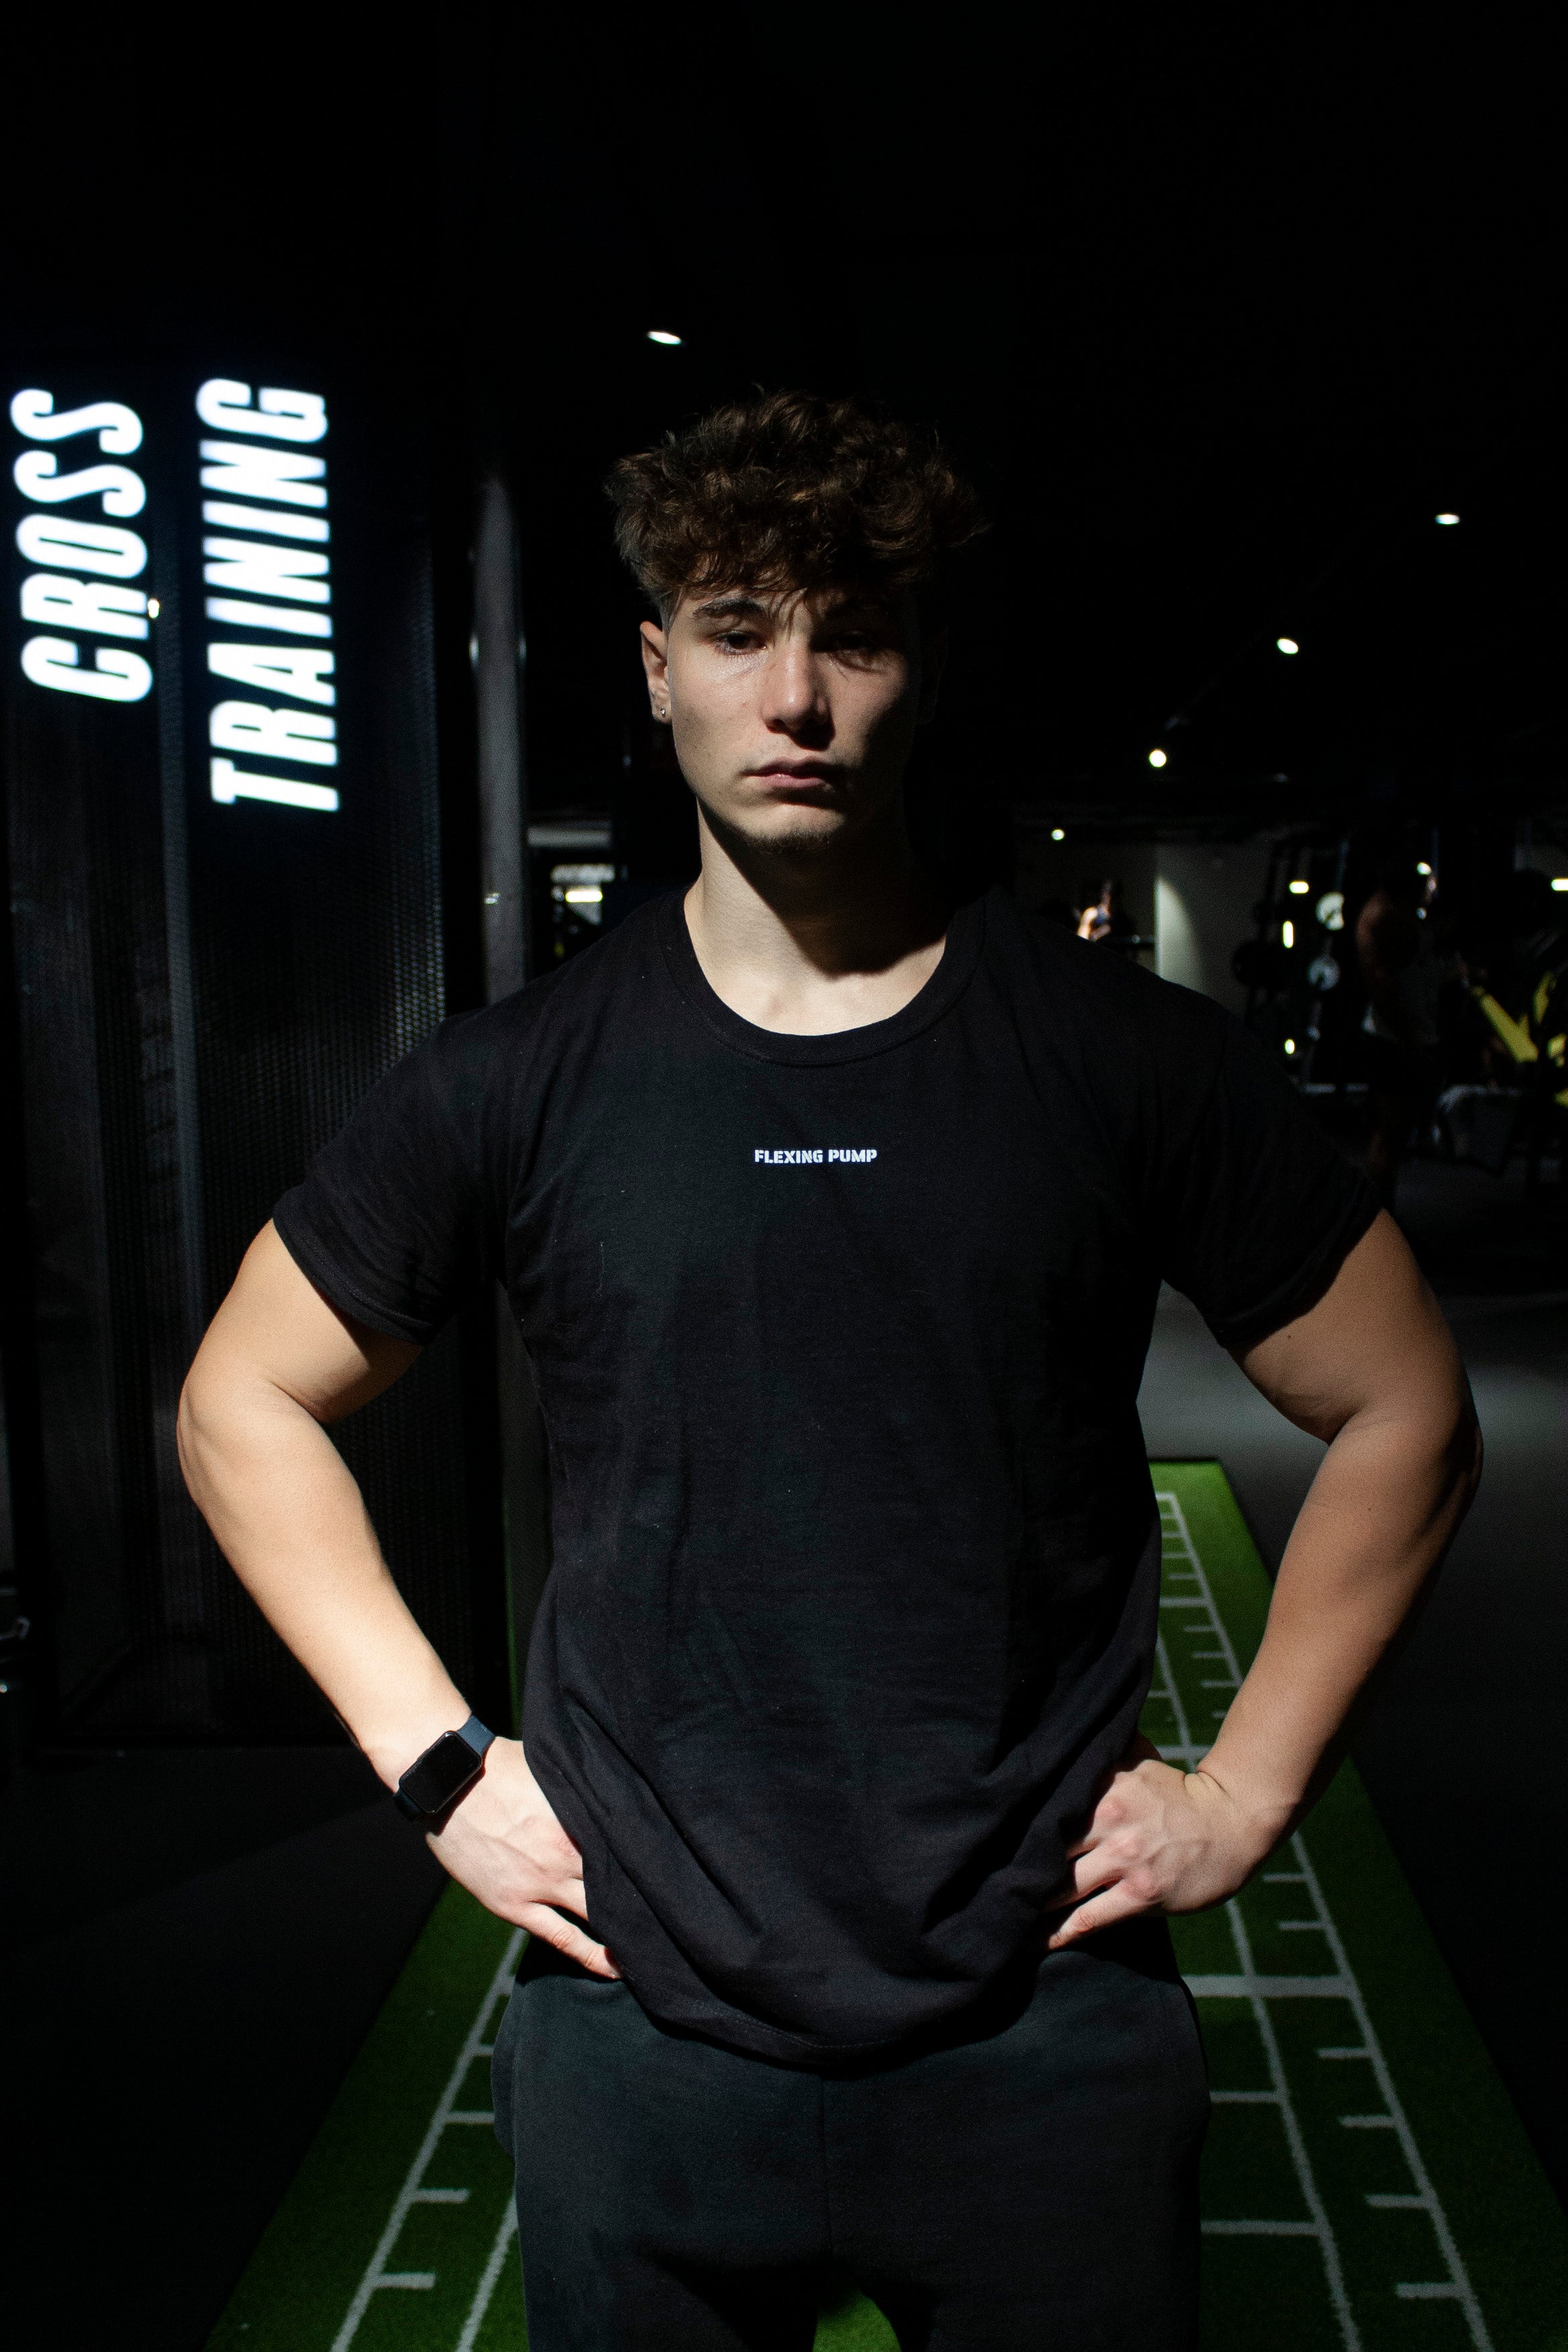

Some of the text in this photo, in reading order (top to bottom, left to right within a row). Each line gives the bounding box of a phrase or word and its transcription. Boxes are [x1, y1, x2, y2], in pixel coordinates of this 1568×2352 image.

[10, 389, 153, 702] CROSS
[196, 378, 339, 812] TRAINING
[754, 1148, 877, 1164] FLEXING PUMP
